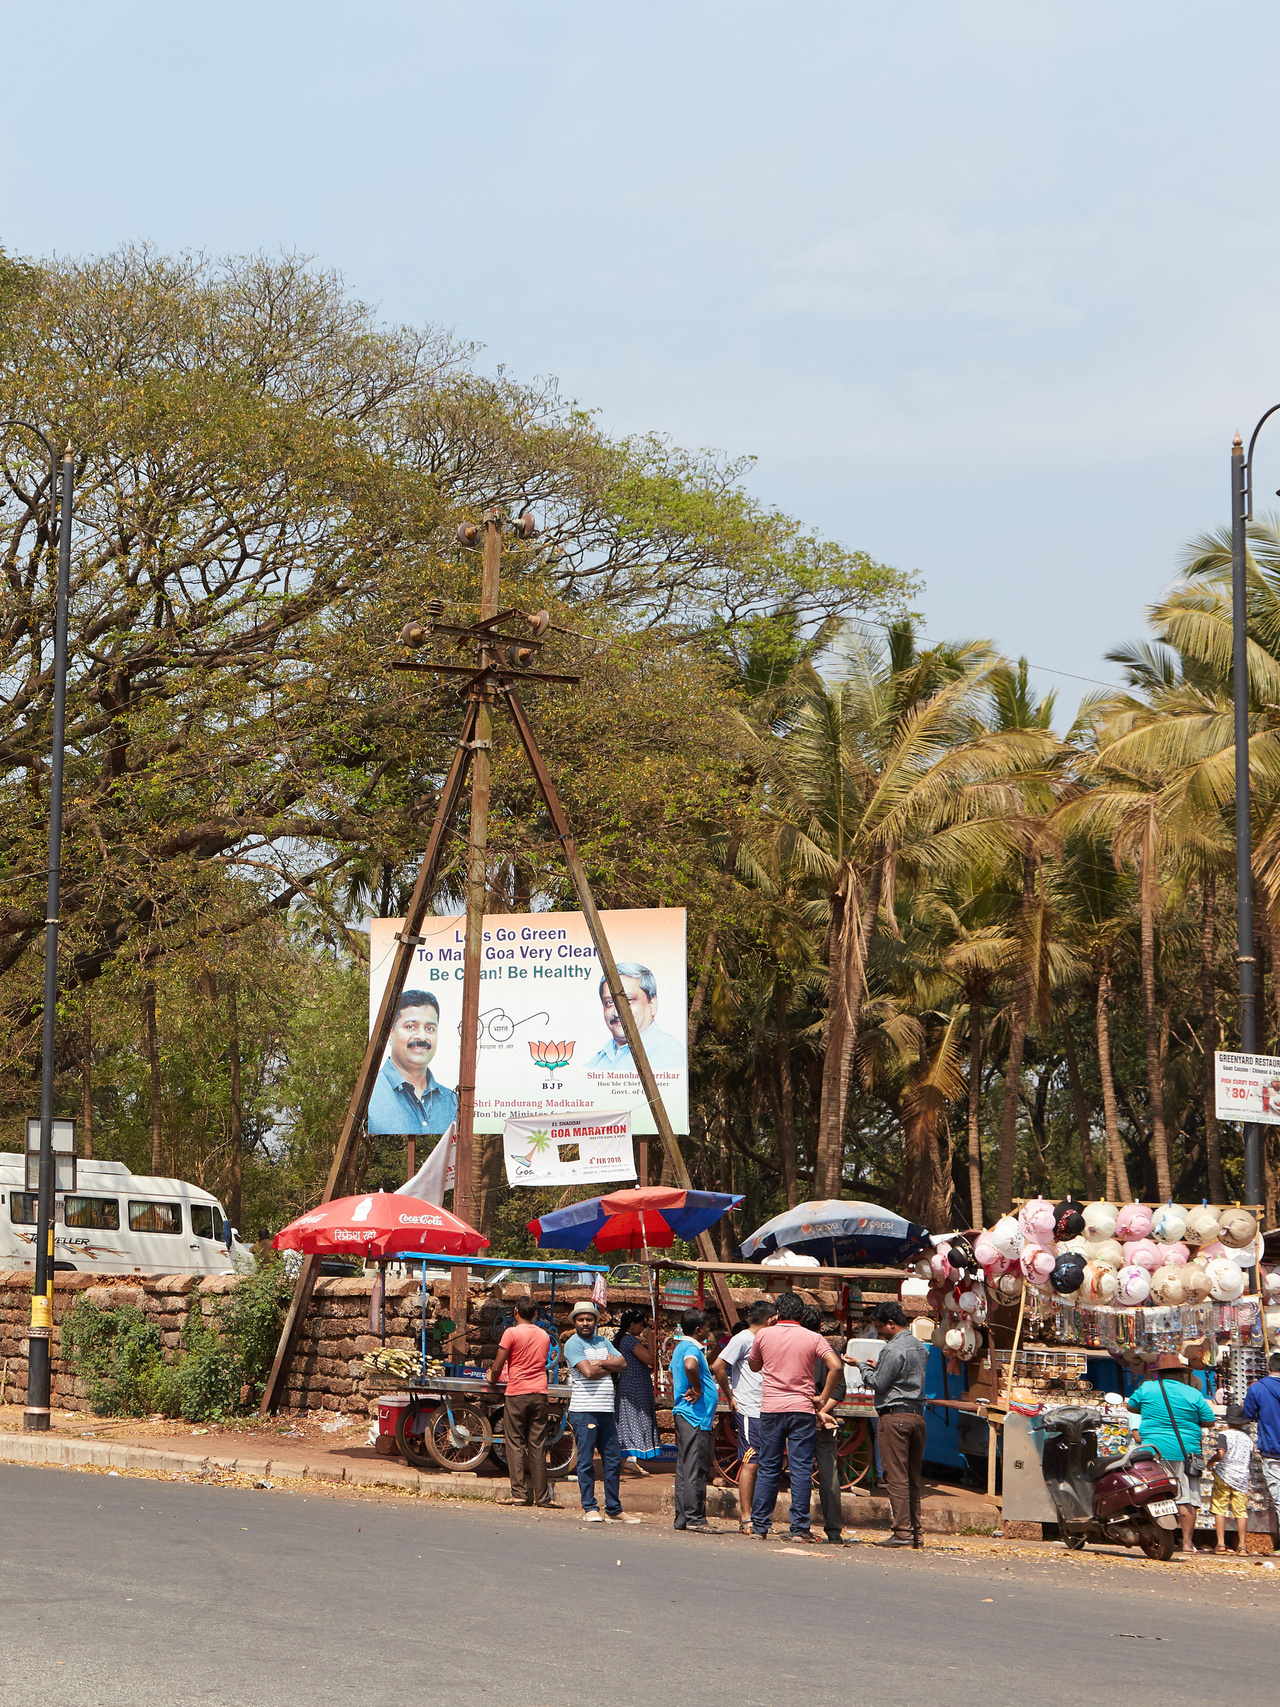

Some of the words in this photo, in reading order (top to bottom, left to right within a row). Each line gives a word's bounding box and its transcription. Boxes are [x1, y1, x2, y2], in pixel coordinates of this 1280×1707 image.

[496, 928, 516, 942] Go
[521, 927, 566, 941] Green
[418, 949, 433, 962] To
[485, 946, 515, 960] Goa
[520, 945, 552, 961] Very
[430, 968, 449, 981] Be
[454, 966, 502, 980] Can!
[508, 966, 528, 979] Be
[533, 964, 592, 980] Healthy
[1219, 1054, 1253, 1065] GREENYARD
[542, 1082, 564, 1090] BJP
[473, 1099, 491, 1108] Shri
[494, 1099, 542, 1109] Pandurang
[546, 1099, 594, 1108] Madkaikar
[550, 1128, 570, 1138] GOA
[573, 1124, 627, 1137] MARATHON
[607, 1156, 622, 1164] 2018
[516, 1166, 534, 1176] Goa
[398, 1214, 444, 1226] Coca-Cola
[870, 1220, 894, 1230] pepsi
